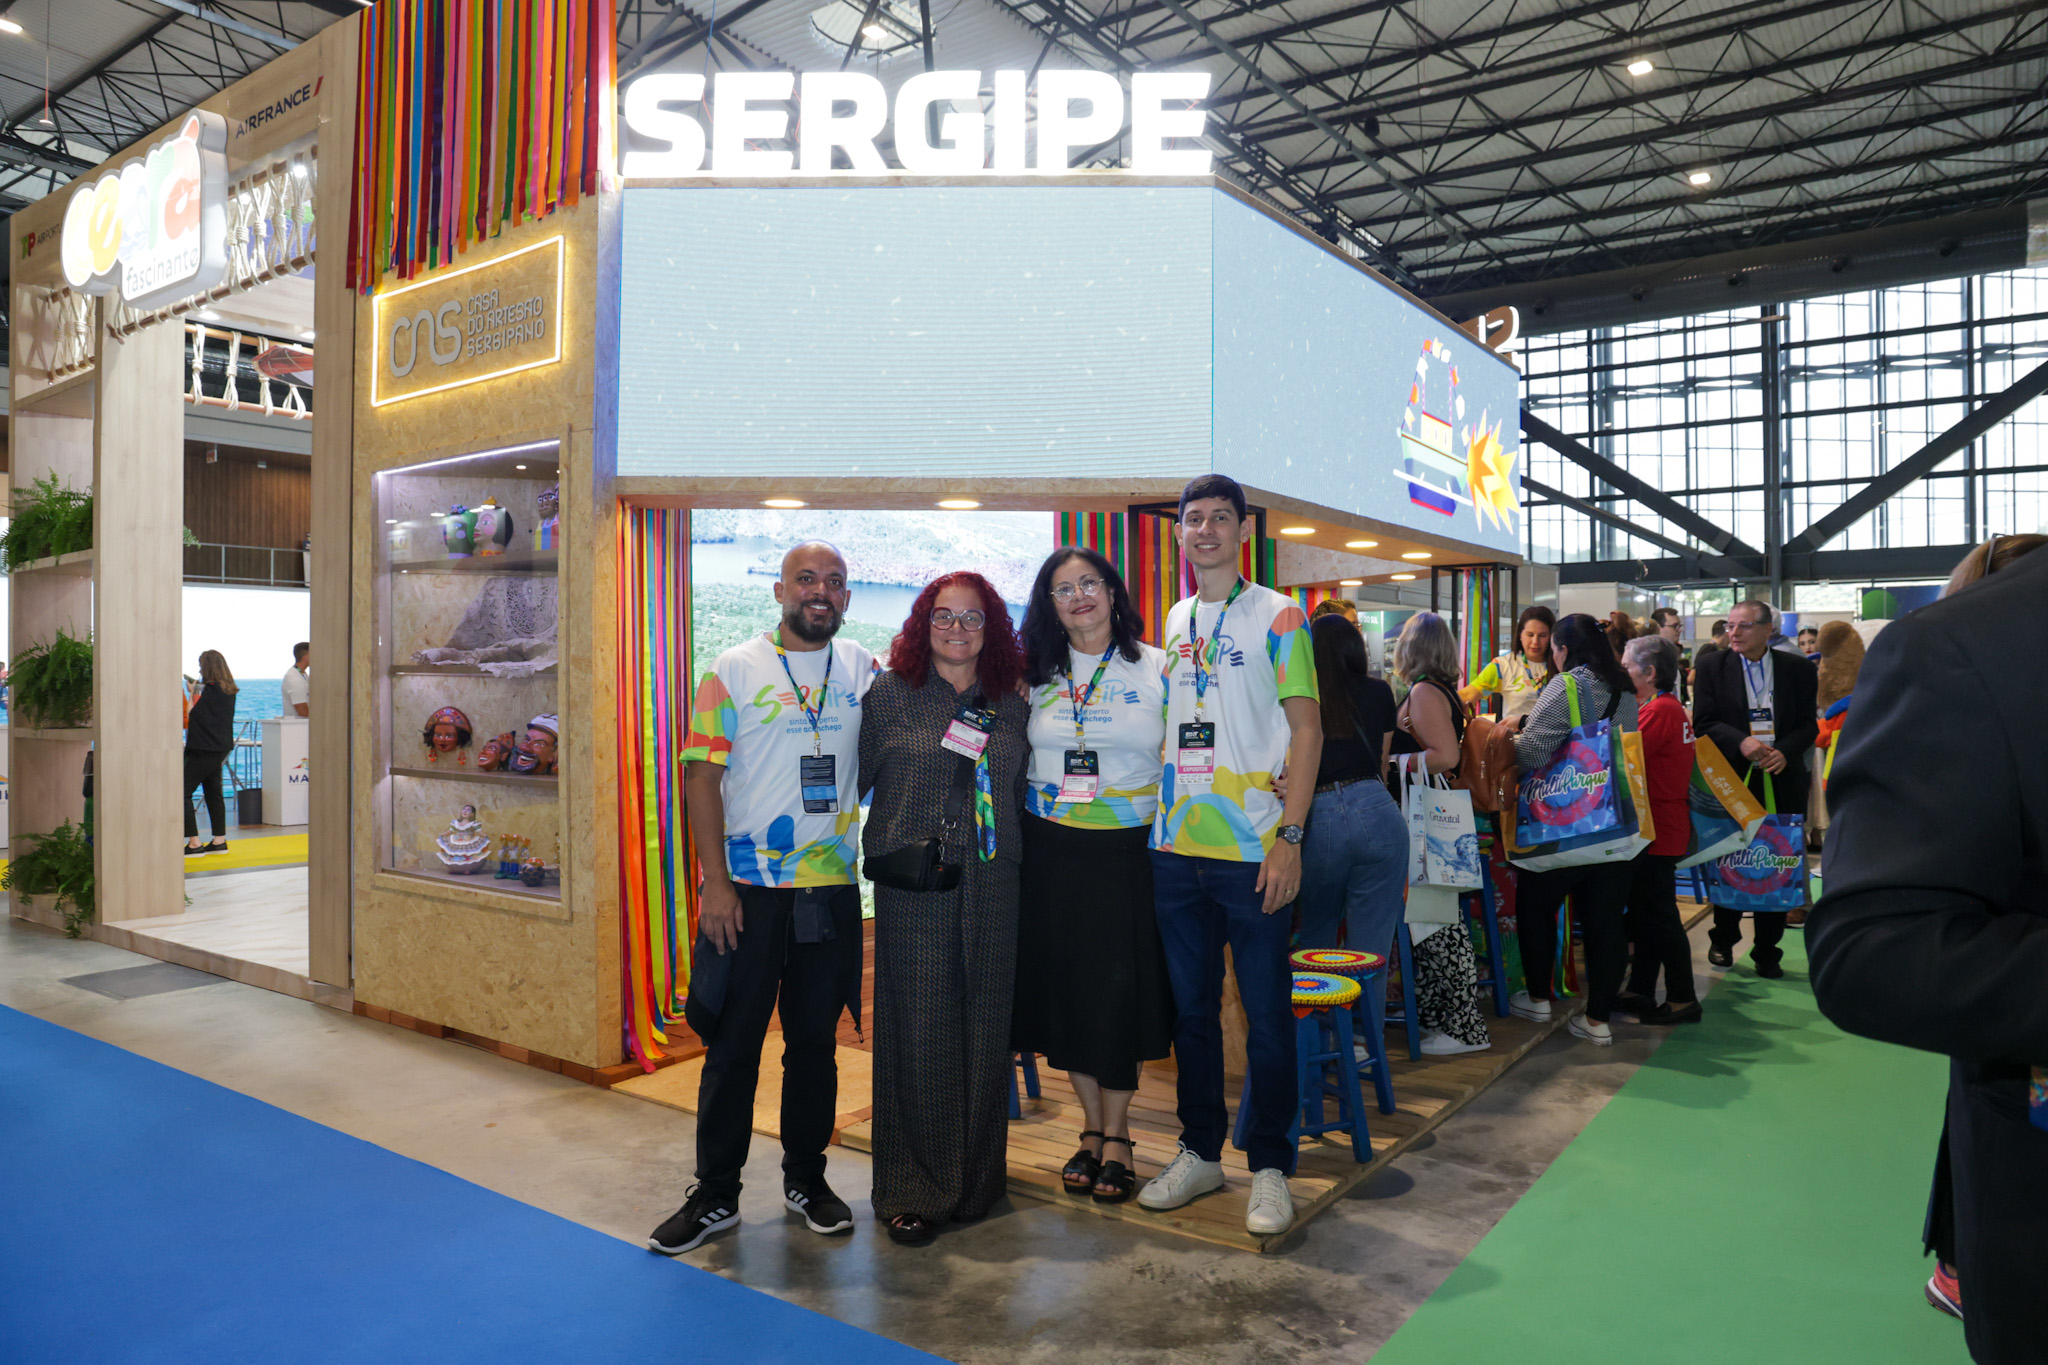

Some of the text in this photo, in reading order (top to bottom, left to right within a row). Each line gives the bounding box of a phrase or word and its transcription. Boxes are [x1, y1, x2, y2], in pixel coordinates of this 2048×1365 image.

[236, 84, 311, 139] AIRFRANCE
[622, 69, 1214, 175] SERGIPE
[126, 247, 199, 294] fascinante
[467, 289, 500, 316] CASA
[466, 318, 545, 357] SERGIPANO
[467, 314, 484, 336] DO
[789, 718, 808, 726] sinta
[1088, 708, 1110, 717] perto
[786, 726, 802, 734] esse
[1523, 765, 1609, 804] MultiParque
[1716, 845, 1800, 874] MultiParque
